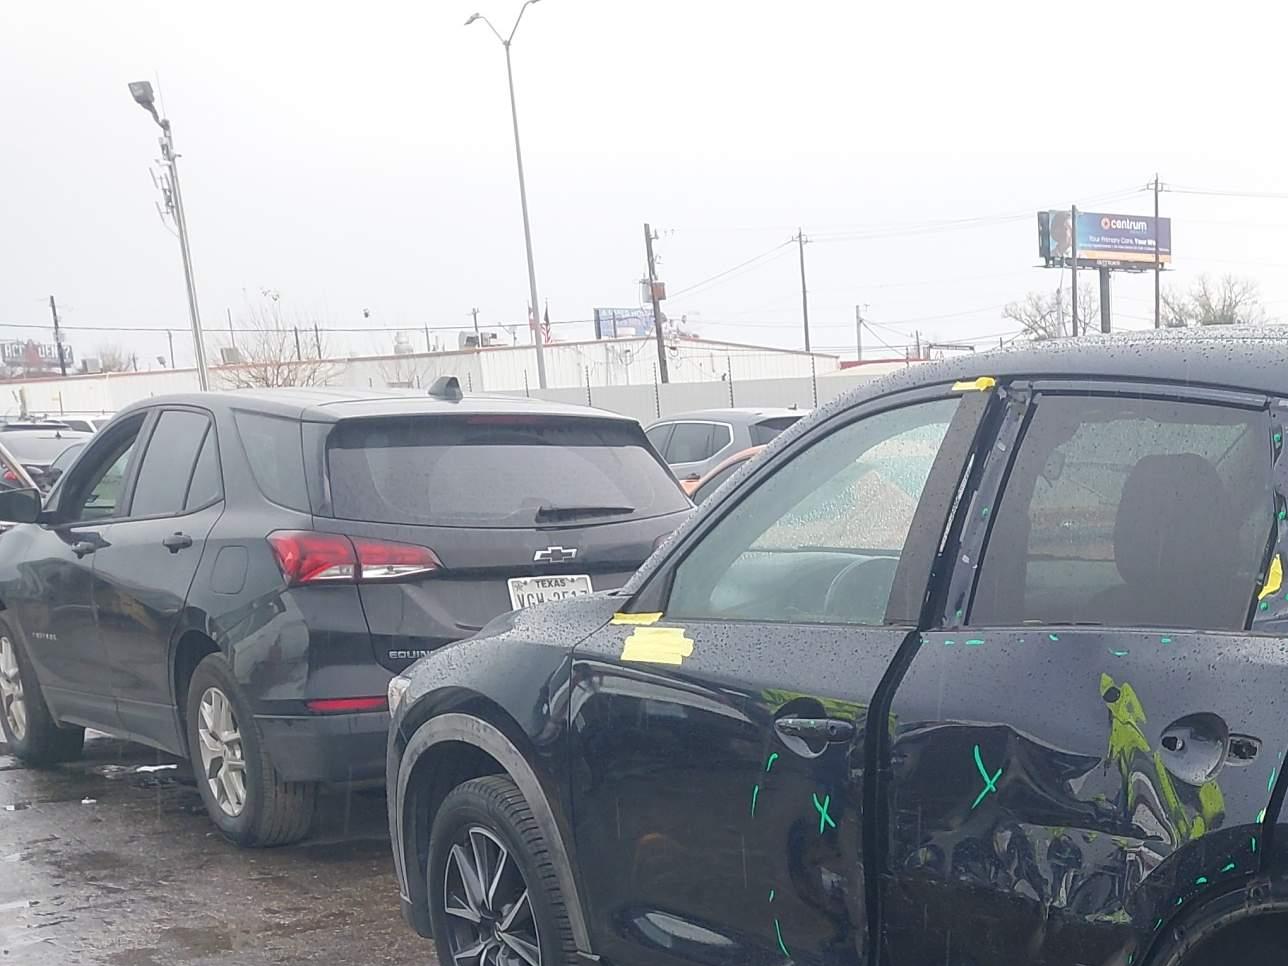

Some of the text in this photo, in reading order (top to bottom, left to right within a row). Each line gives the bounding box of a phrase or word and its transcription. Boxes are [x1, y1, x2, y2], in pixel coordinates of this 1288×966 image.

[1111, 218, 1147, 232] centrum
[535, 579, 567, 588] TEXAS
[389, 650, 433, 659] EQUIN
